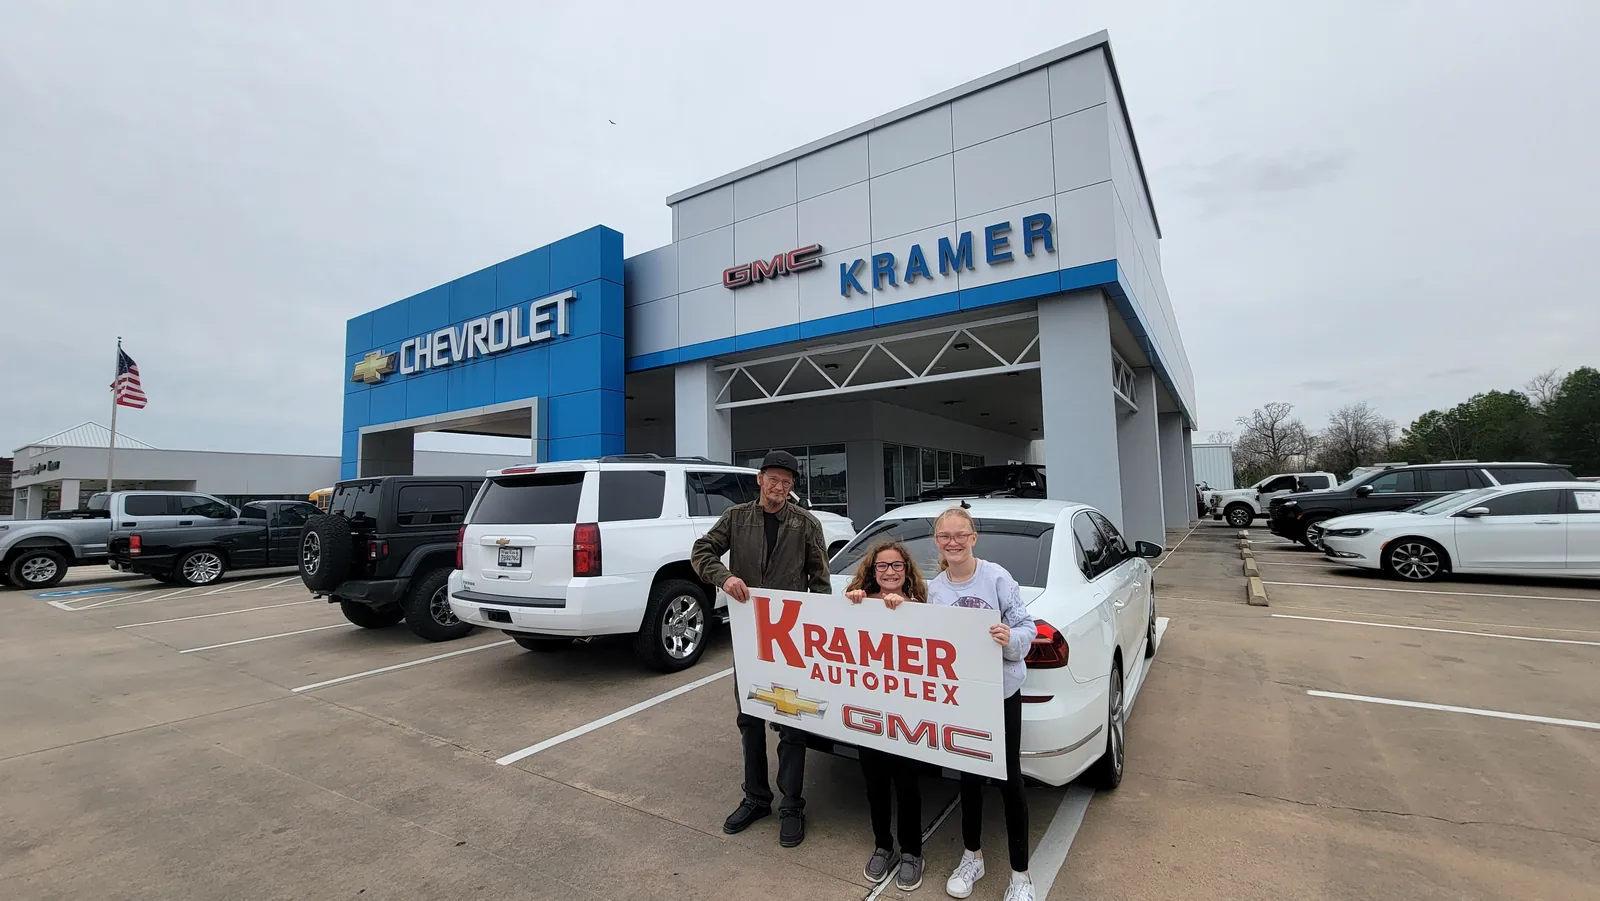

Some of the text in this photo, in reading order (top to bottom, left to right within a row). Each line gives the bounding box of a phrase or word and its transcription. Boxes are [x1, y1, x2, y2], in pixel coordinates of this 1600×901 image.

[723, 243, 822, 290] GMC
[839, 212, 1055, 298] KRAMER
[400, 289, 577, 376] CHEVROLET
[751, 596, 960, 681] KRAMER
[810, 662, 960, 707] AUTOPLEX
[841, 703, 994, 763] GMC
